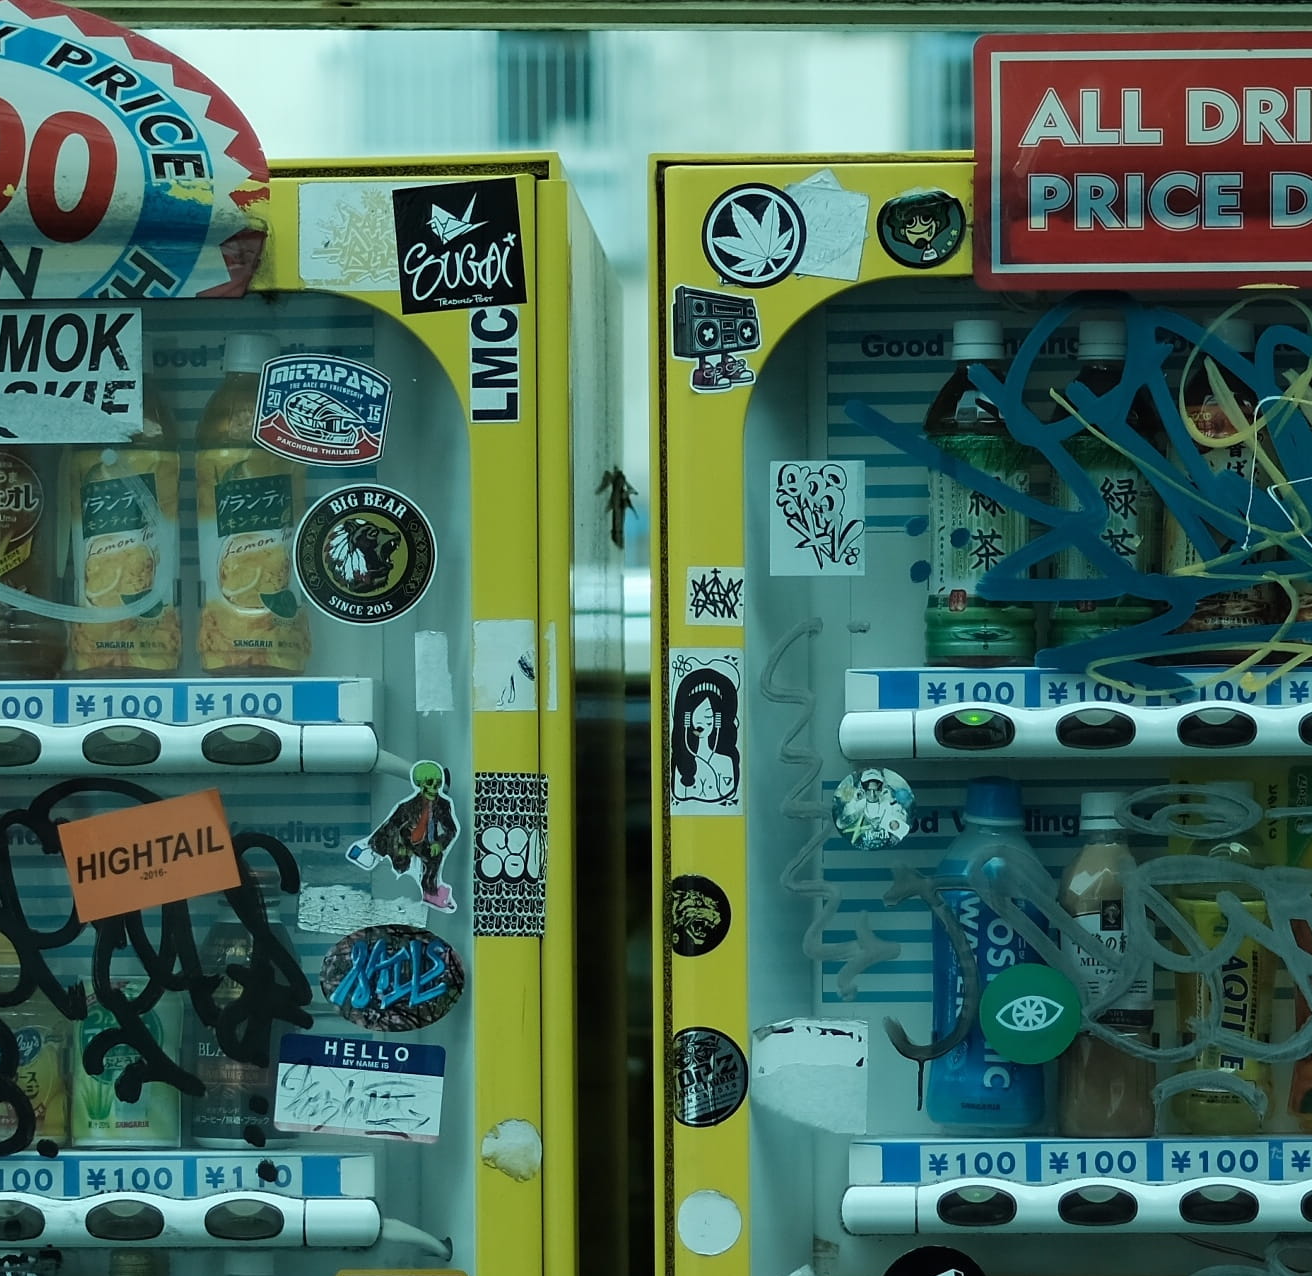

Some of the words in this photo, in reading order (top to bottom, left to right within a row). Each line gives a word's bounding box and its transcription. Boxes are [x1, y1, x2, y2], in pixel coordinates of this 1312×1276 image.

[42, 42, 206, 186] PRICE
[1020, 86, 1163, 147] ALL
[1027, 172, 1244, 231] PRICE
[860, 333, 945, 359] Good
[470, 308, 519, 421] LMC
[276, 435, 318, 453] PAKCHONG
[322, 448, 360, 457] THAILAND
[329, 494, 359, 516] BIG
[364, 492, 408, 519] BEAR
[328, 595, 363, 616] SINCE
[367, 601, 394, 616] 2015
[95, 640, 134, 649] SANGARIA
[233, 639, 274, 648] SANGARIA
[927, 682, 1014, 705] ¥100
[76, 825, 225, 885] HIGHTAIL
[140, 867, 168, 881] -2016-
[324, 1039, 410, 1062] HELLO
[342, 1058, 352, 1066] MY
[353, 1060, 378, 1068] NAME
[929, 1152, 1015, 1176] ¥100
